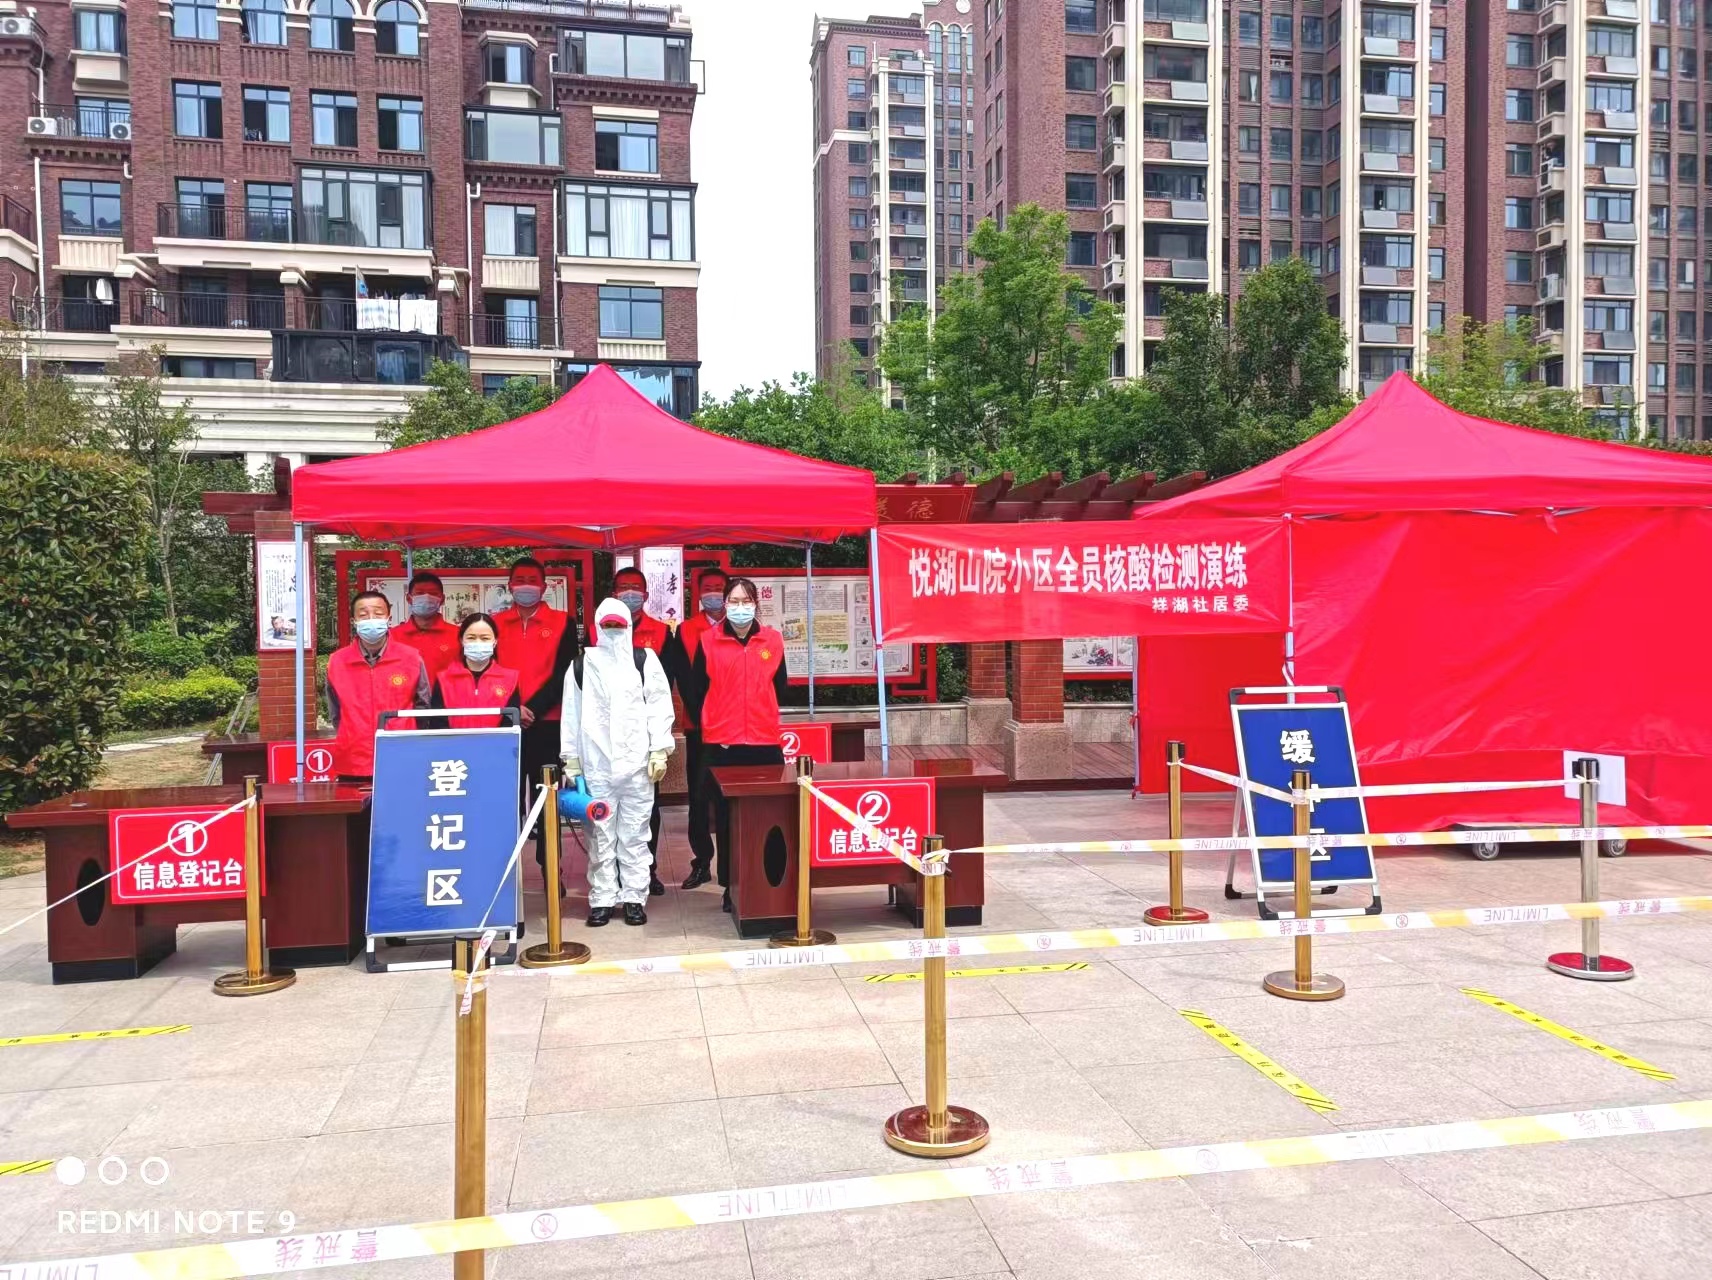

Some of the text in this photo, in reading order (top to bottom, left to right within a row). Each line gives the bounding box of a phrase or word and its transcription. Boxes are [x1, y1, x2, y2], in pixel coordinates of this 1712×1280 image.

[909, 541, 1247, 598] 悦湖山院小区全员核酸检测演练
[1152, 595, 1249, 614] 祥湖社居委
[426, 759, 469, 907] 登记区
[133, 857, 243, 891] 信息登记台
[1484, 907, 1550, 922] LIMITLINE
[1133, 926, 1206, 943] LIMITLINE
[746, 948, 826, 966] LIMITLINE
